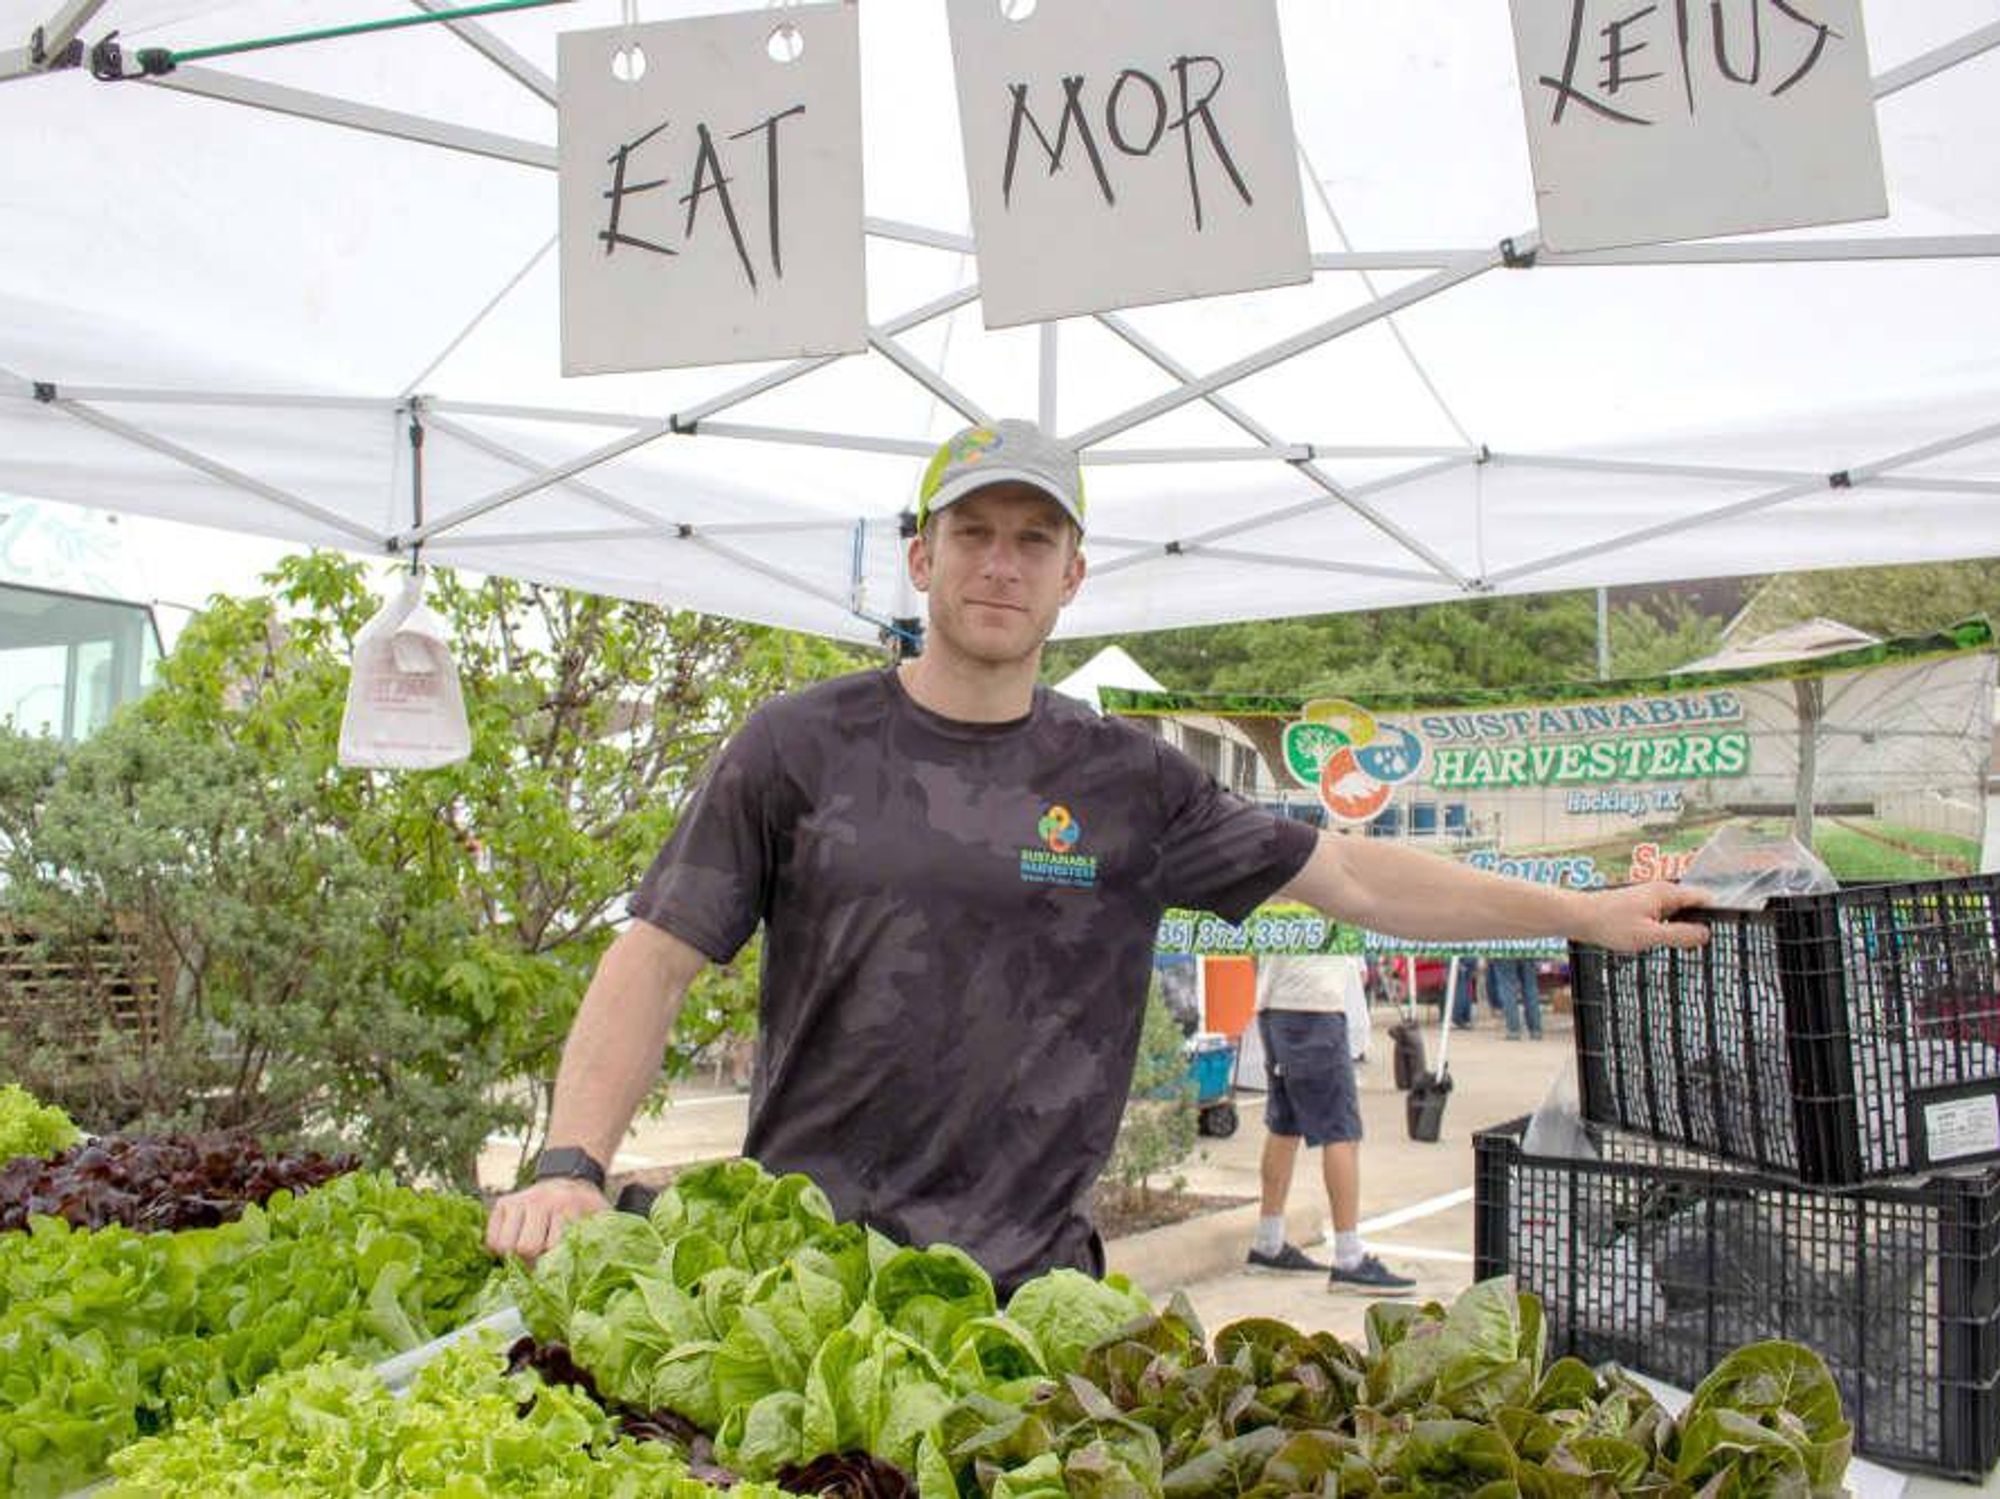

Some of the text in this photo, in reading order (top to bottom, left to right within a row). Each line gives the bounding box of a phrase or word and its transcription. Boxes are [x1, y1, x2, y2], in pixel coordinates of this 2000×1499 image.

[1002, 55, 1253, 232] MOR
[599, 105, 805, 293] EAT
[1421, 692, 1743, 740] SUSTAINABLE
[1433, 733, 1748, 787] HARVESTERS
[1254, 917, 1325, 946] 3375
